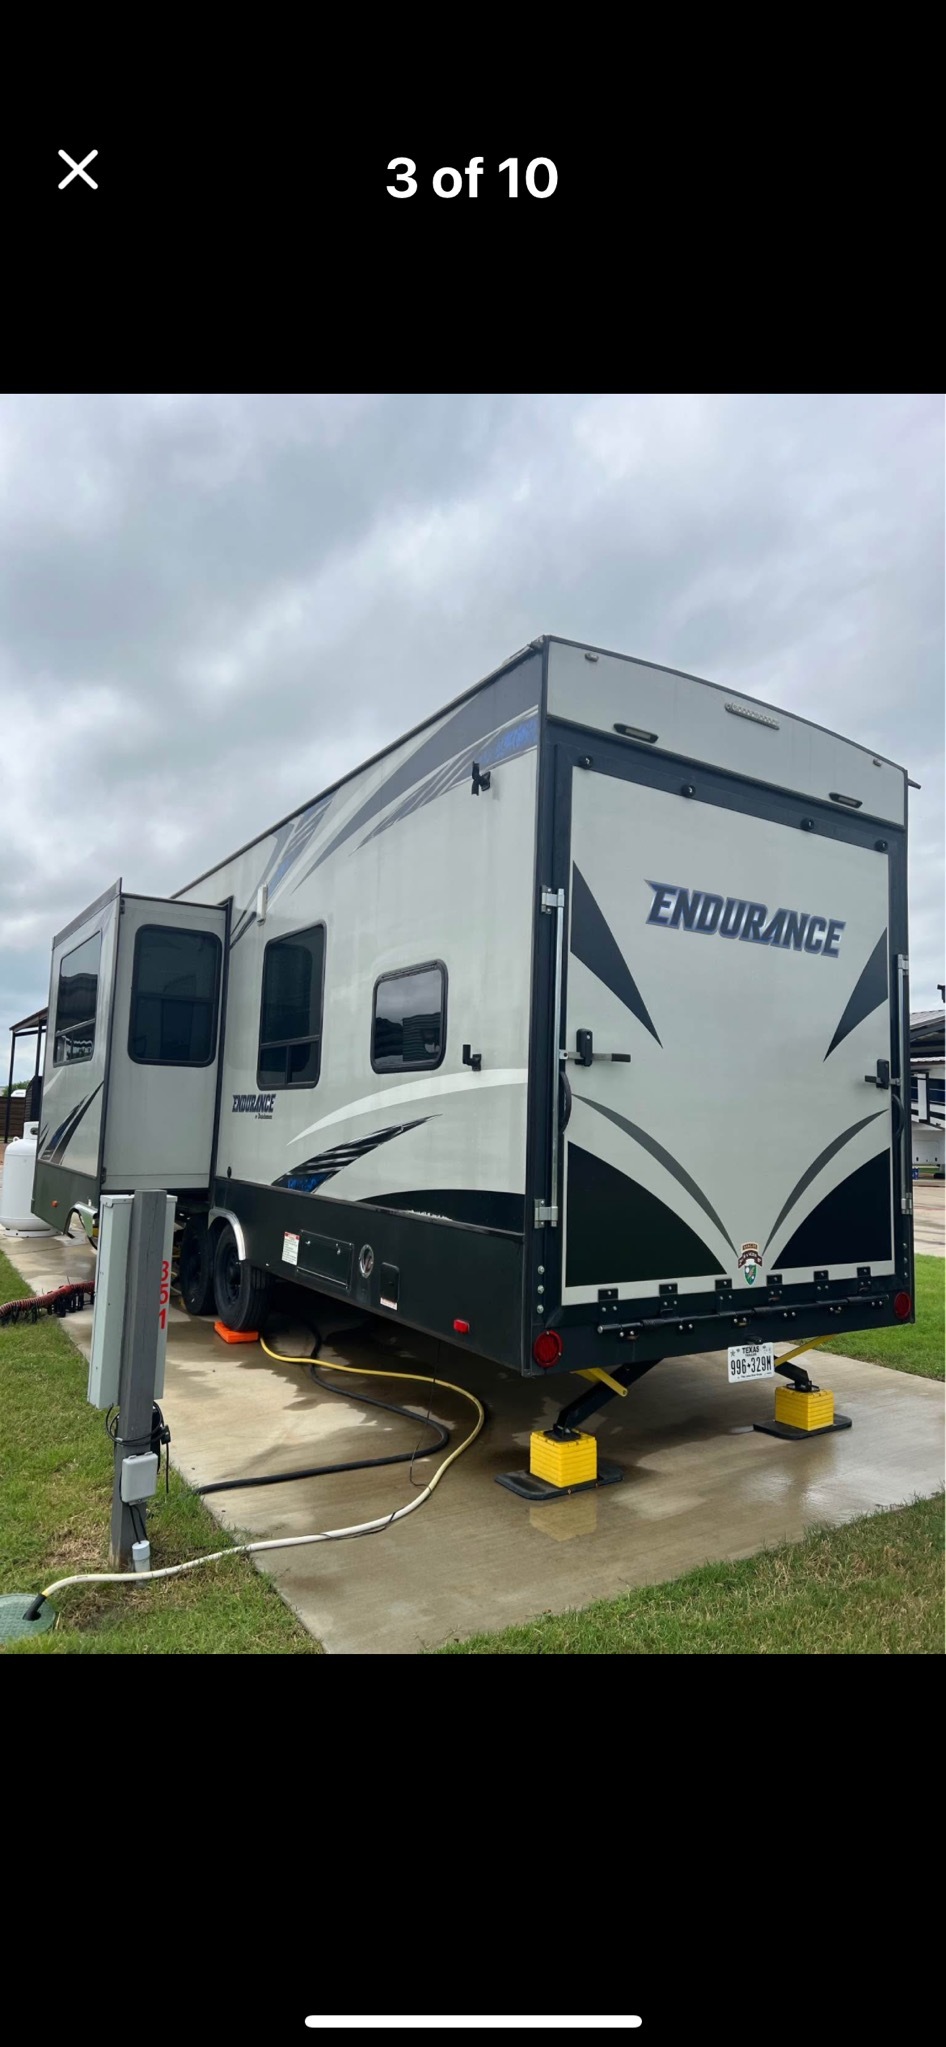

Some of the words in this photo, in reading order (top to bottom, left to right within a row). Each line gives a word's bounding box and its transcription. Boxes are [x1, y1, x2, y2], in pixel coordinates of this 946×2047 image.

[643, 879, 847, 959] ENDURANCE
[231, 1093, 277, 1113] ENDURANCE
[741, 1345, 760, 1354] TEXAS
